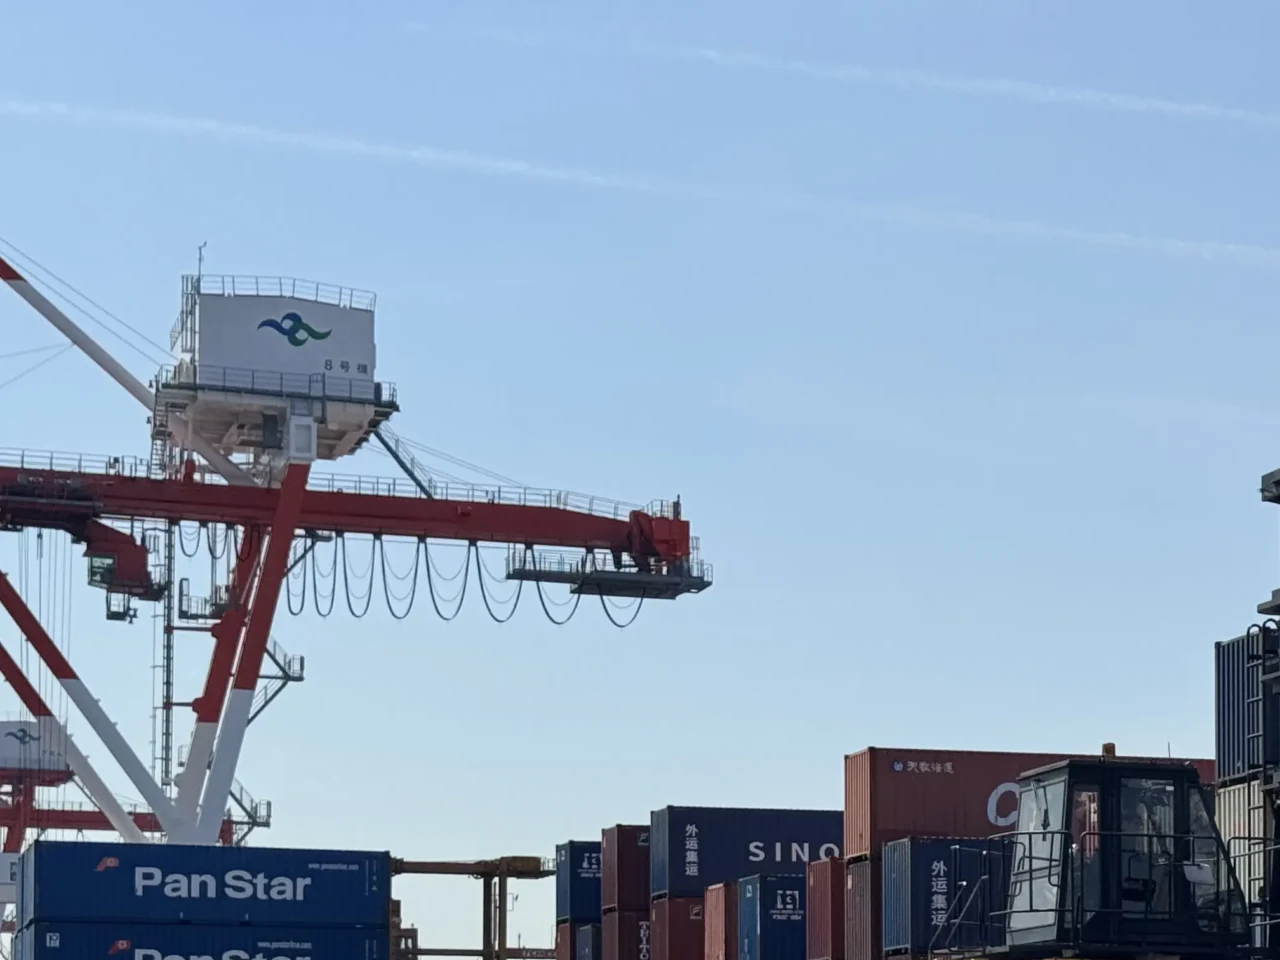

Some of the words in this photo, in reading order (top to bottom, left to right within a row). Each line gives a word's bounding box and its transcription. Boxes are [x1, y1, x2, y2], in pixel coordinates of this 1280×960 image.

[685, 823, 699, 877] 外运集运
[748, 841, 841, 862] SINO
[931, 860, 949, 926] 外运集运
